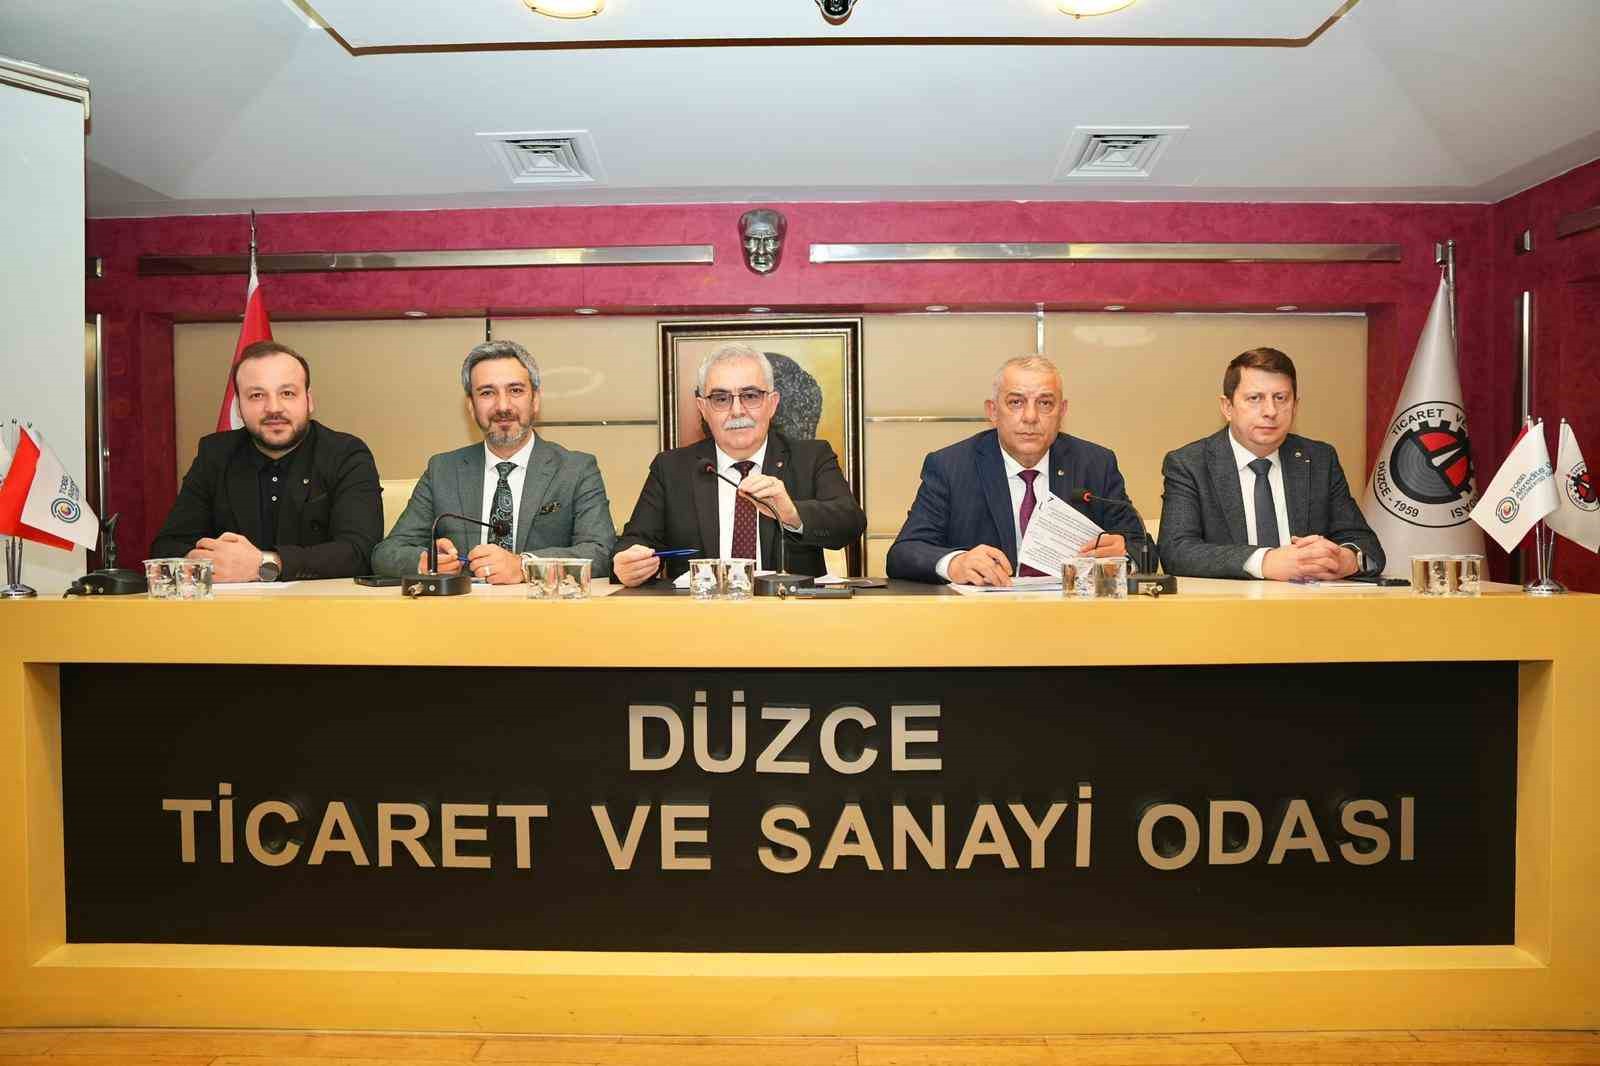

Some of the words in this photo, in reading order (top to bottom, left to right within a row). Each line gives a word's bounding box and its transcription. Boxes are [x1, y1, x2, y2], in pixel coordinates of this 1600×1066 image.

[1393, 500, 1420, 518] 1959
[628, 690, 943, 774] DÜZCE
[162, 782, 549, 870] TİCARET
[590, 804, 712, 872] VE
[757, 784, 1092, 874] SANAYİ
[1137, 796, 1415, 871] ODASI
